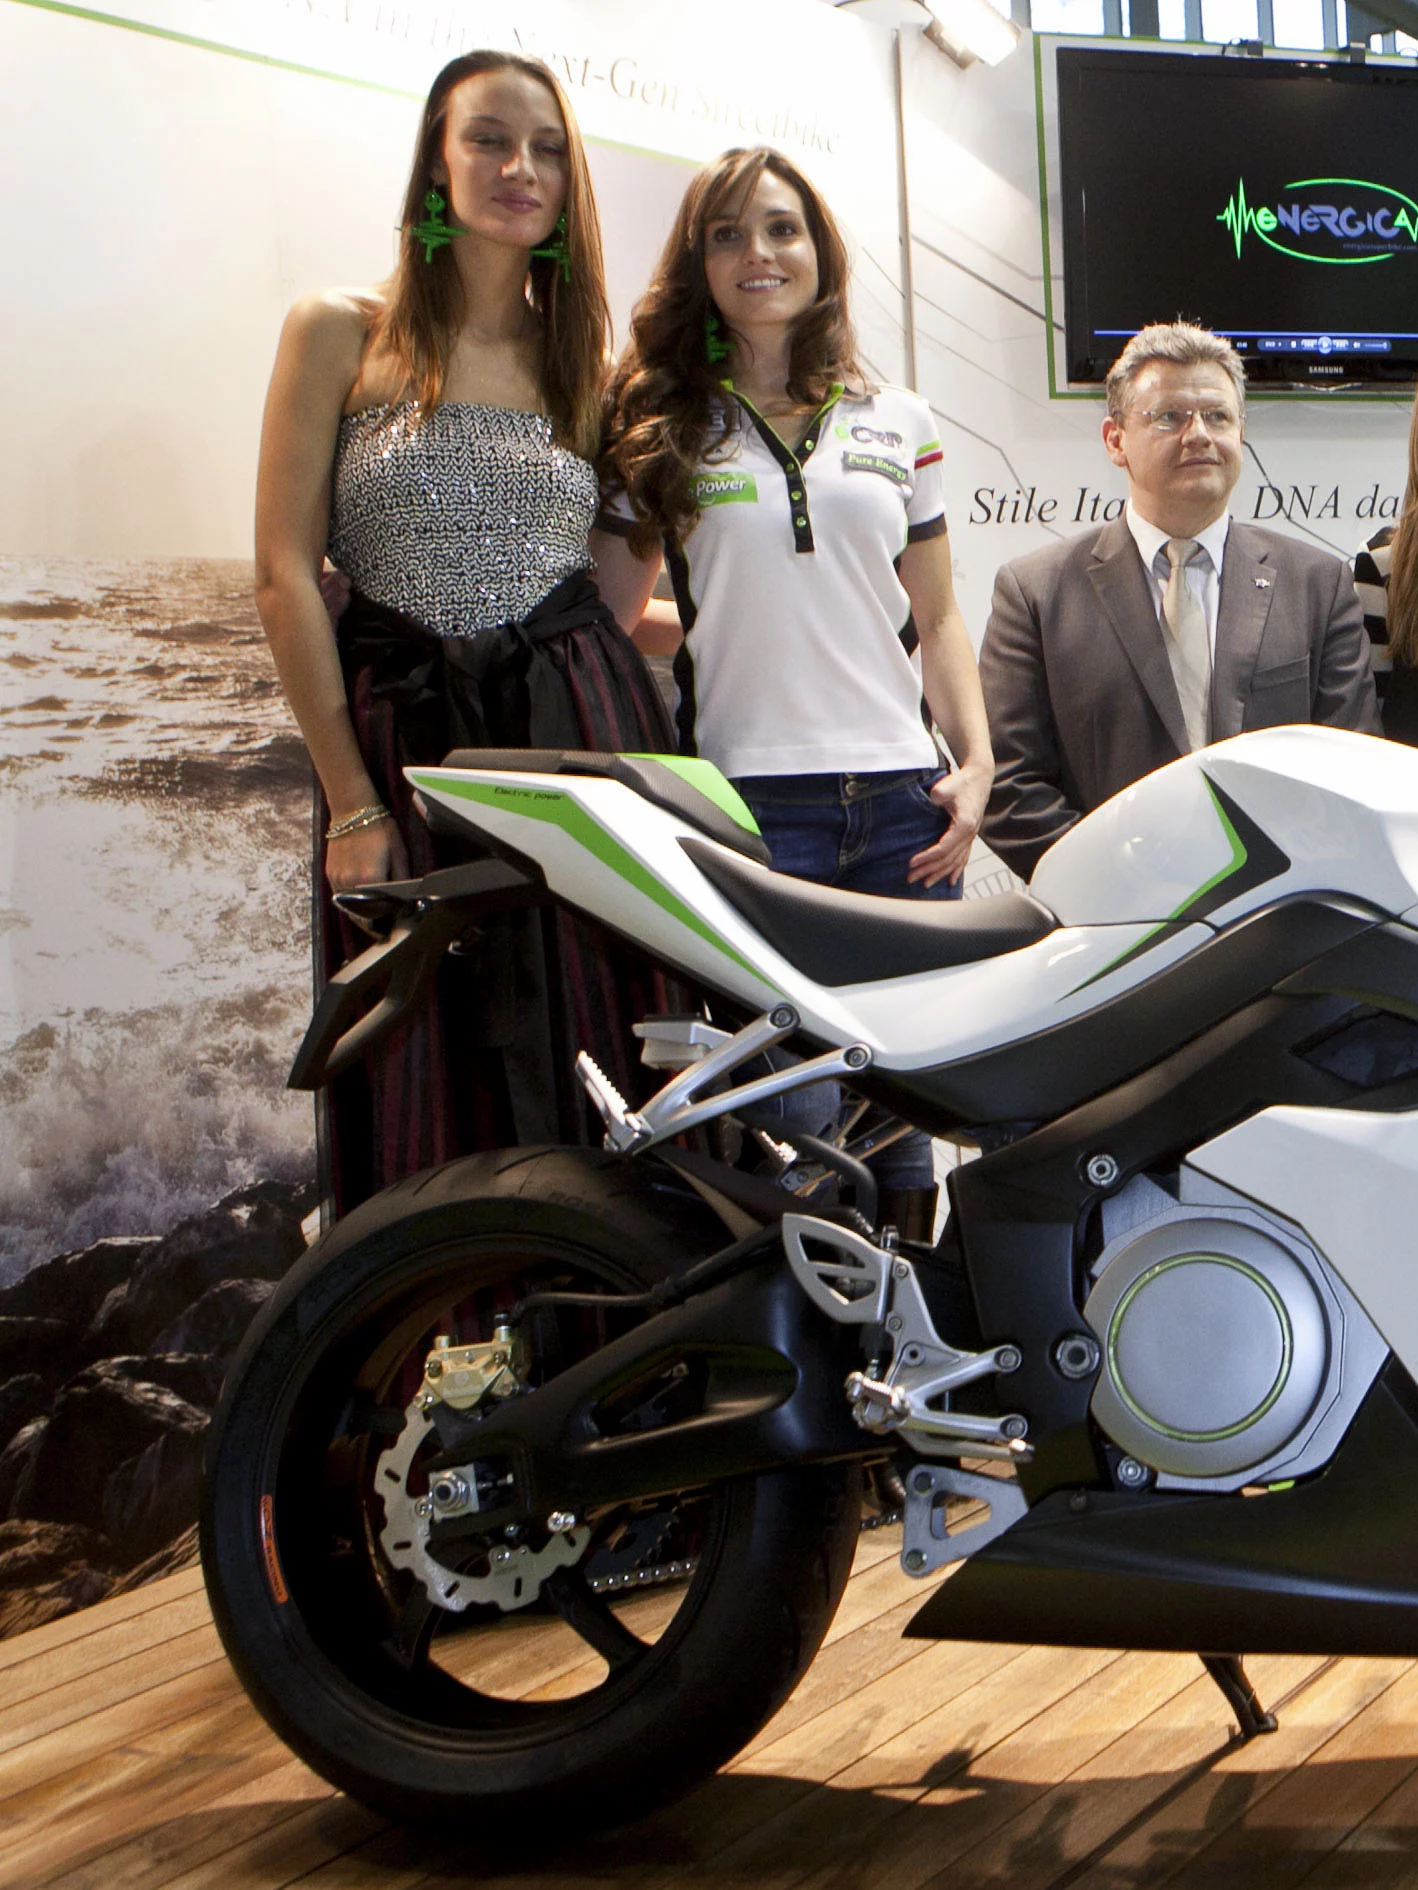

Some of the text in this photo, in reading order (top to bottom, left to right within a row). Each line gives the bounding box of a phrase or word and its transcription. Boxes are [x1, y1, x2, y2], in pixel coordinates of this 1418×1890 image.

[511, 26, 682, 115] Nxt-Gen
[1308, 366, 1344, 374] SAMSUNG
[848, 453, 873, 466] Pure
[970, 485, 1058, 525] Stile
[1252, 484, 1343, 521] DNA
